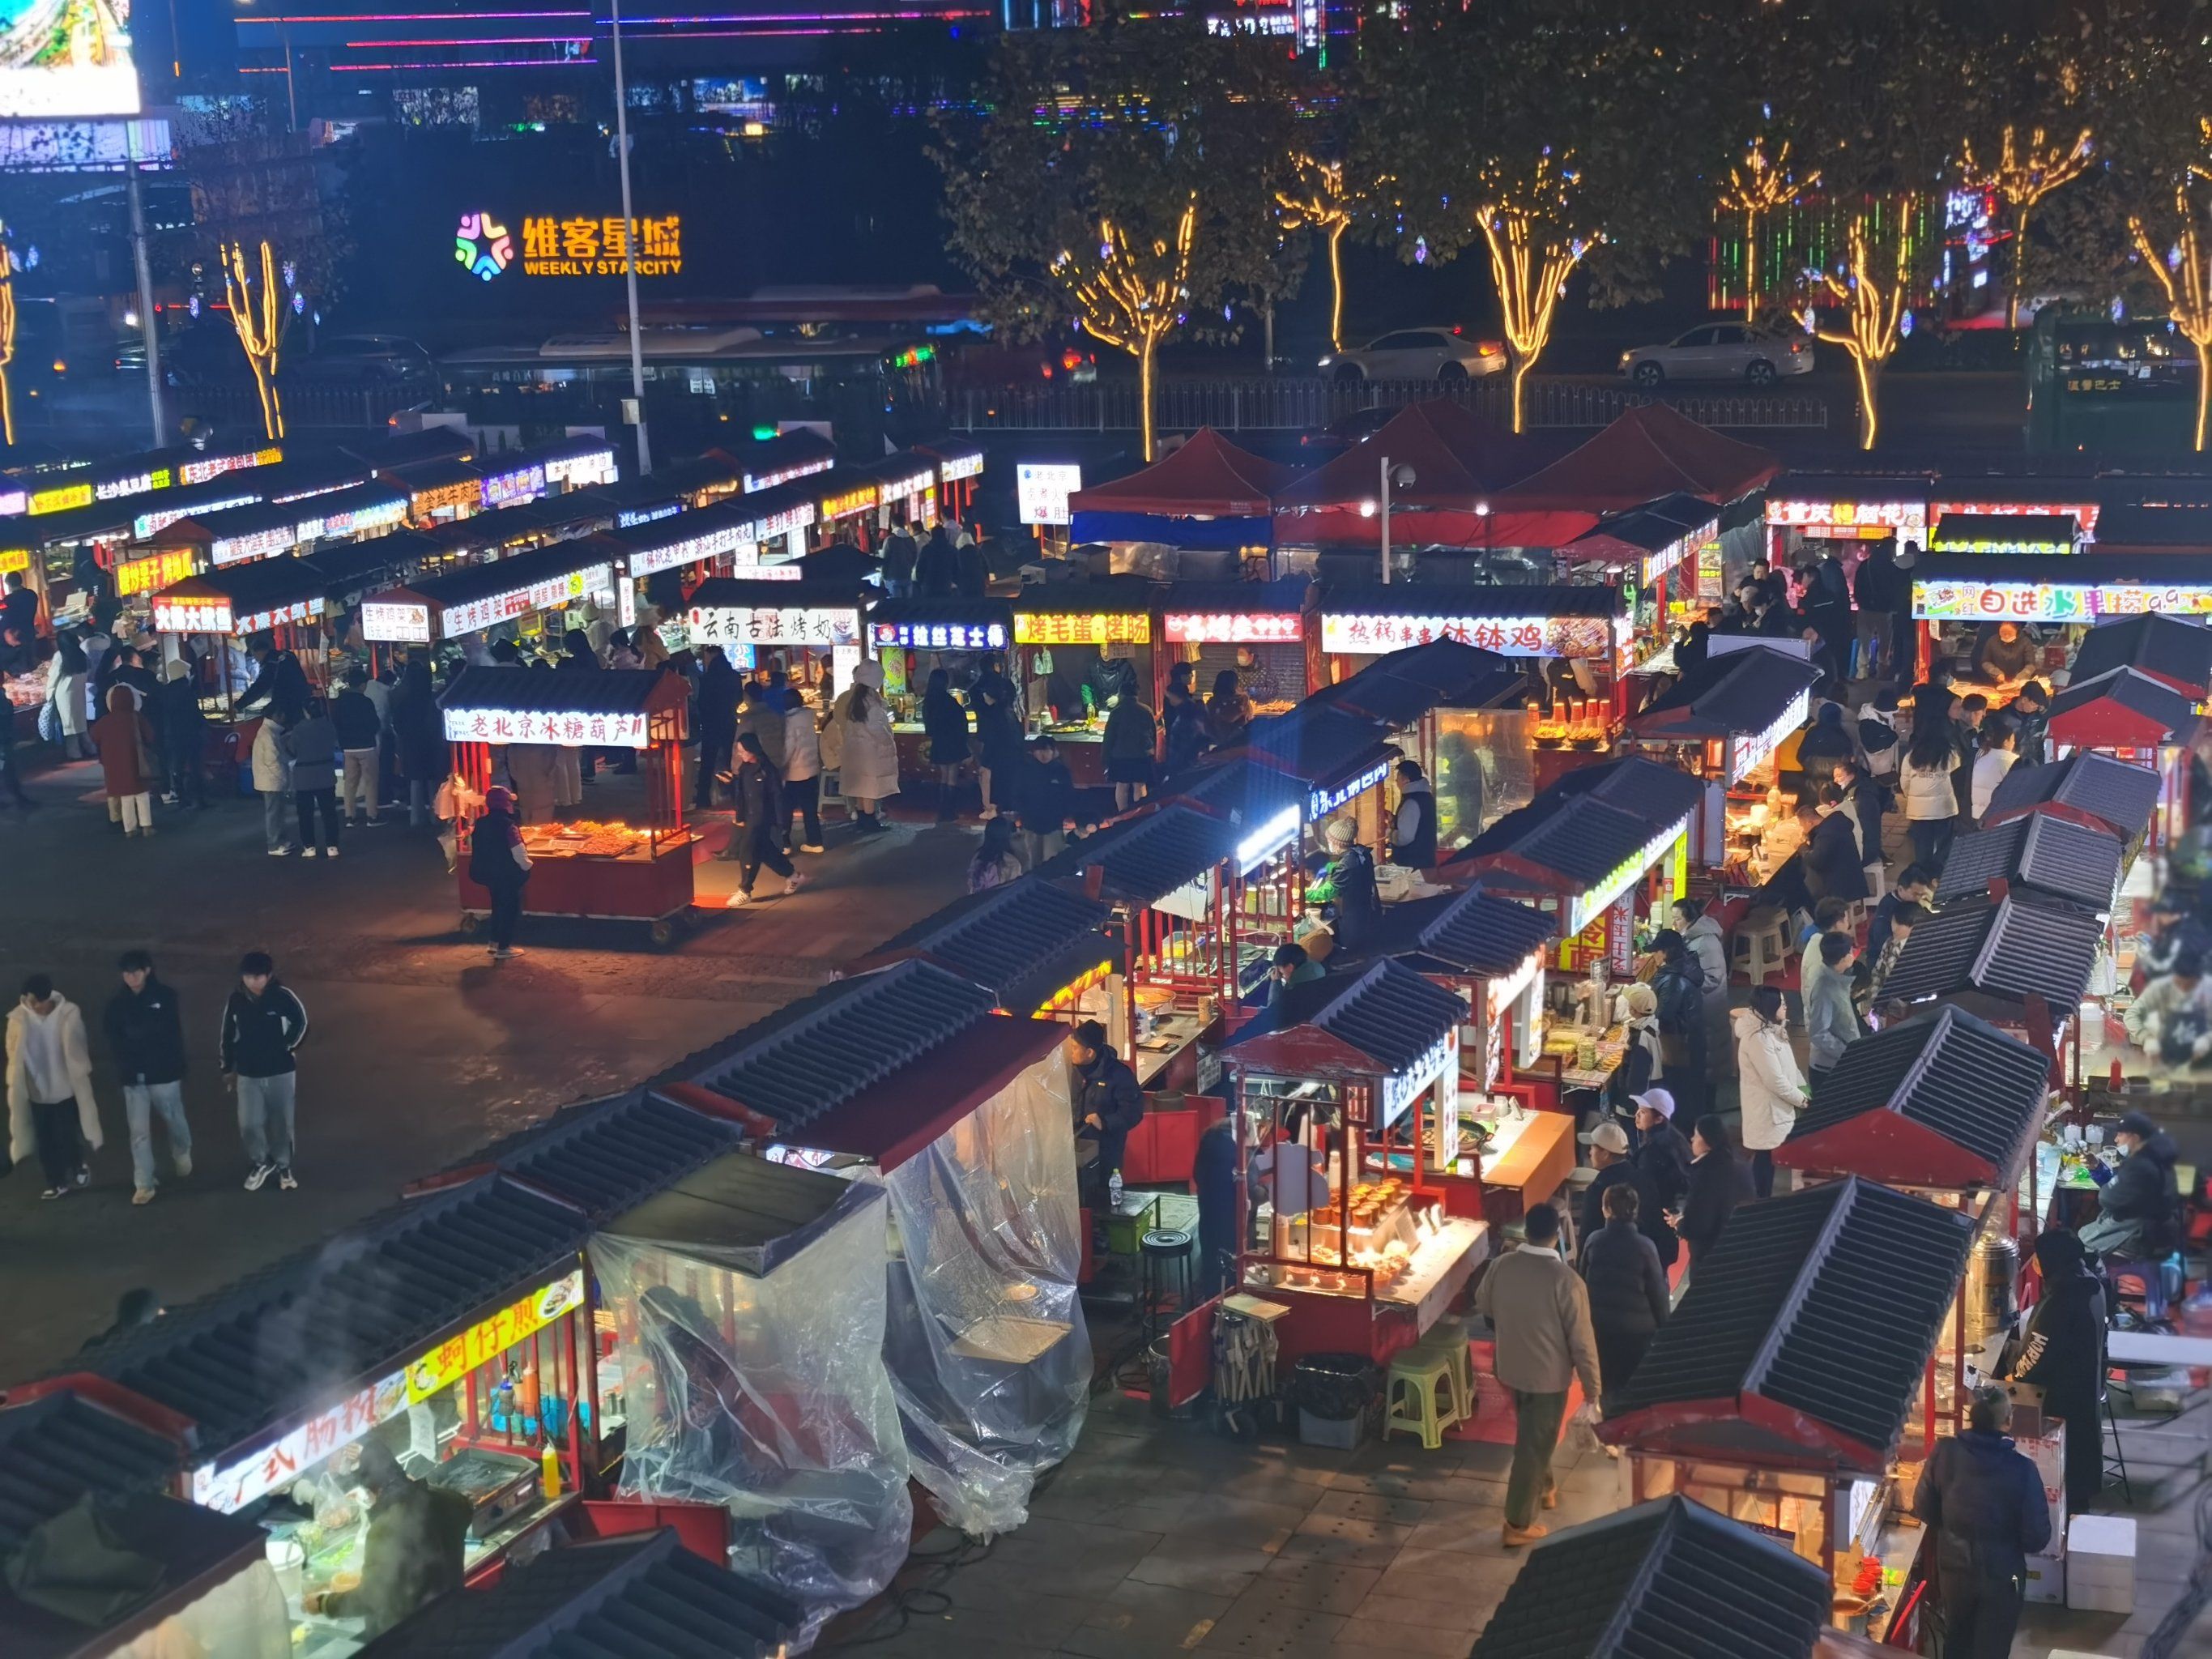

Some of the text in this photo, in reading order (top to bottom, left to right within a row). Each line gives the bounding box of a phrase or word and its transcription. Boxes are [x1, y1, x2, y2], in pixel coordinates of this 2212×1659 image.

[523, 217, 681, 258] 维客星城
[524, 260, 682, 275] WEEKLY STARCITY
[1036, 471, 1067, 480] 老北京
[454, 598, 504, 633] 生烤鸡架
[1980, 588, 2143, 619] 自选水果捞
[703, 611, 832, 642] 云南古法烤奶
[471, 713, 629, 742] 老北京冰糖葫芦
[437, 1296, 539, 1378] 蚵仔煎
